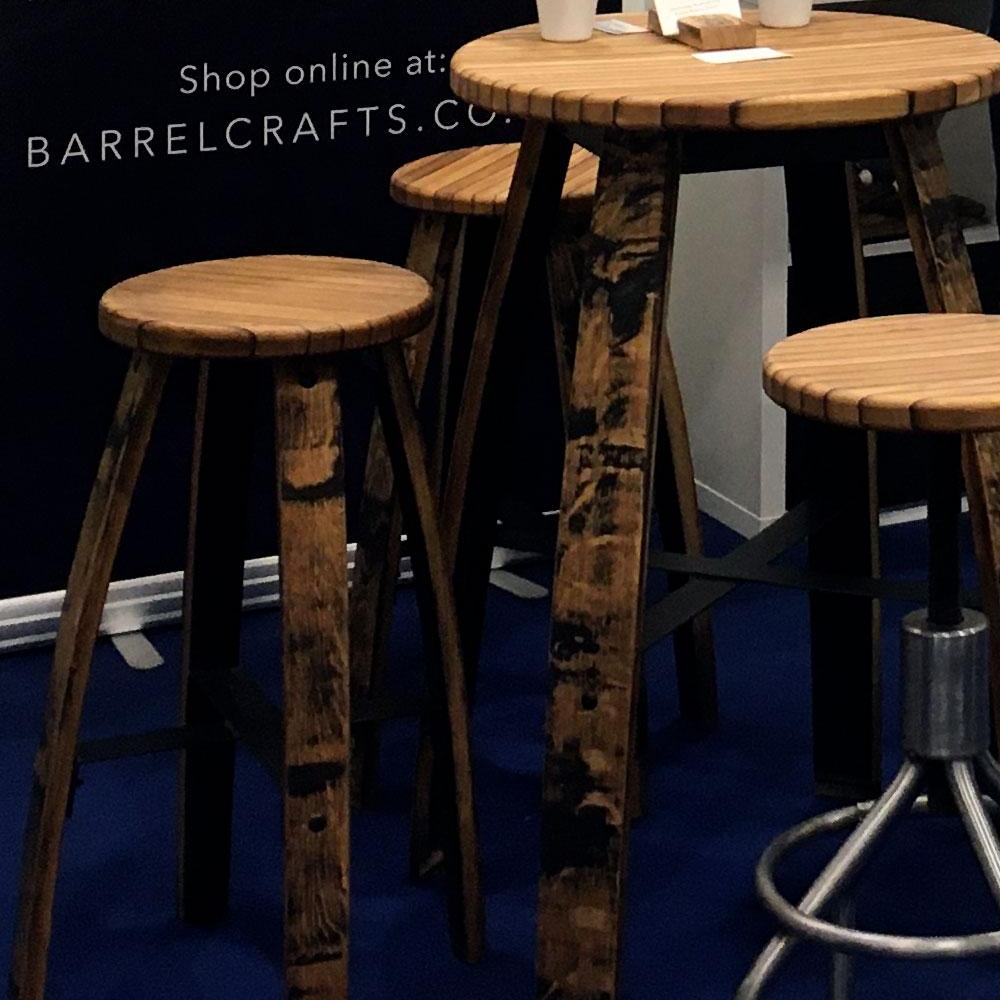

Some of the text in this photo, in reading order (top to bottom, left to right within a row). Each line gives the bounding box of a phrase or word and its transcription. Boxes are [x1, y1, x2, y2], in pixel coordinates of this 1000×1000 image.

[179, 50, 447, 98] Shop online at:
[27, 98, 512, 169] BARRELCRAFTS.CO.
